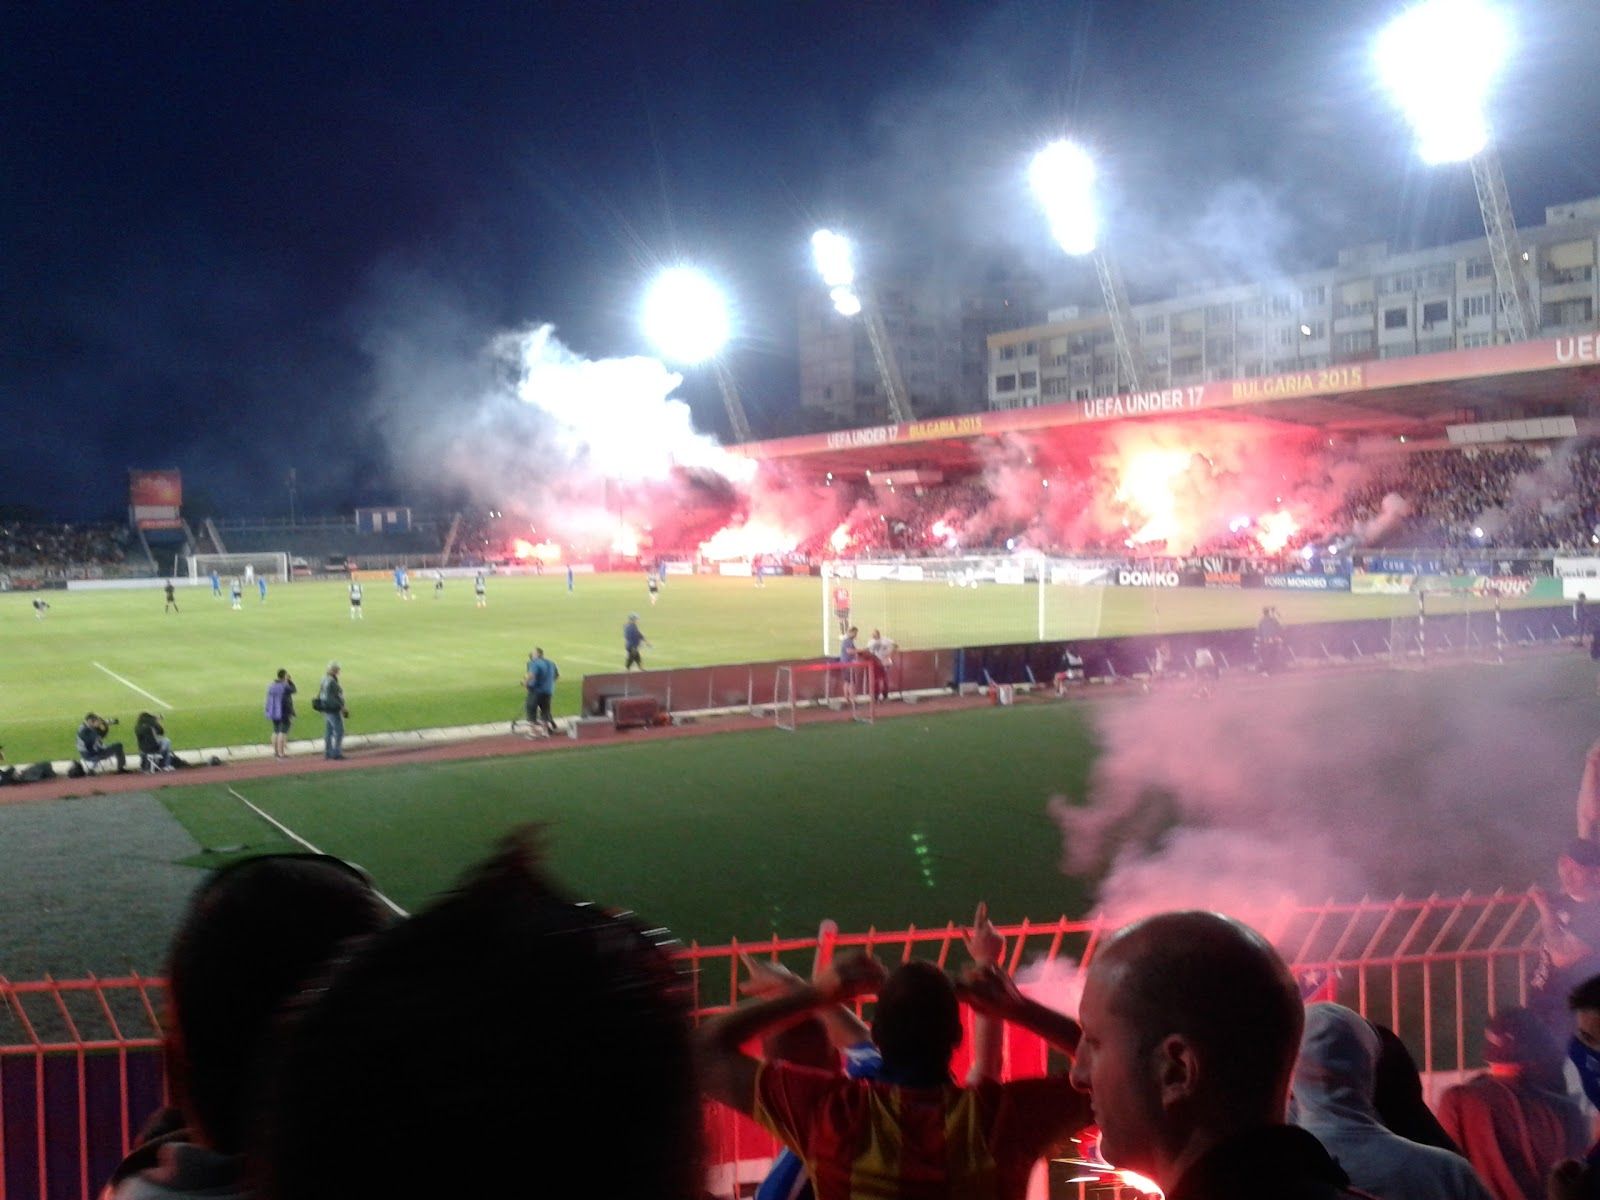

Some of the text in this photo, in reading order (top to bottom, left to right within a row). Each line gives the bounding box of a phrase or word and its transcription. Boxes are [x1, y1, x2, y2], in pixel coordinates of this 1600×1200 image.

[1232, 366, 1363, 401] BULGARIA 2015
[1083, 386, 1205, 419] UEFA UNDER 17
[827, 425, 898, 448] UEFA UNDER 17
[909, 416, 982, 438] BULGARIA 2015
[1118, 571, 1180, 587] DOMKO
[1287, 576, 1327, 589] MONDEO
